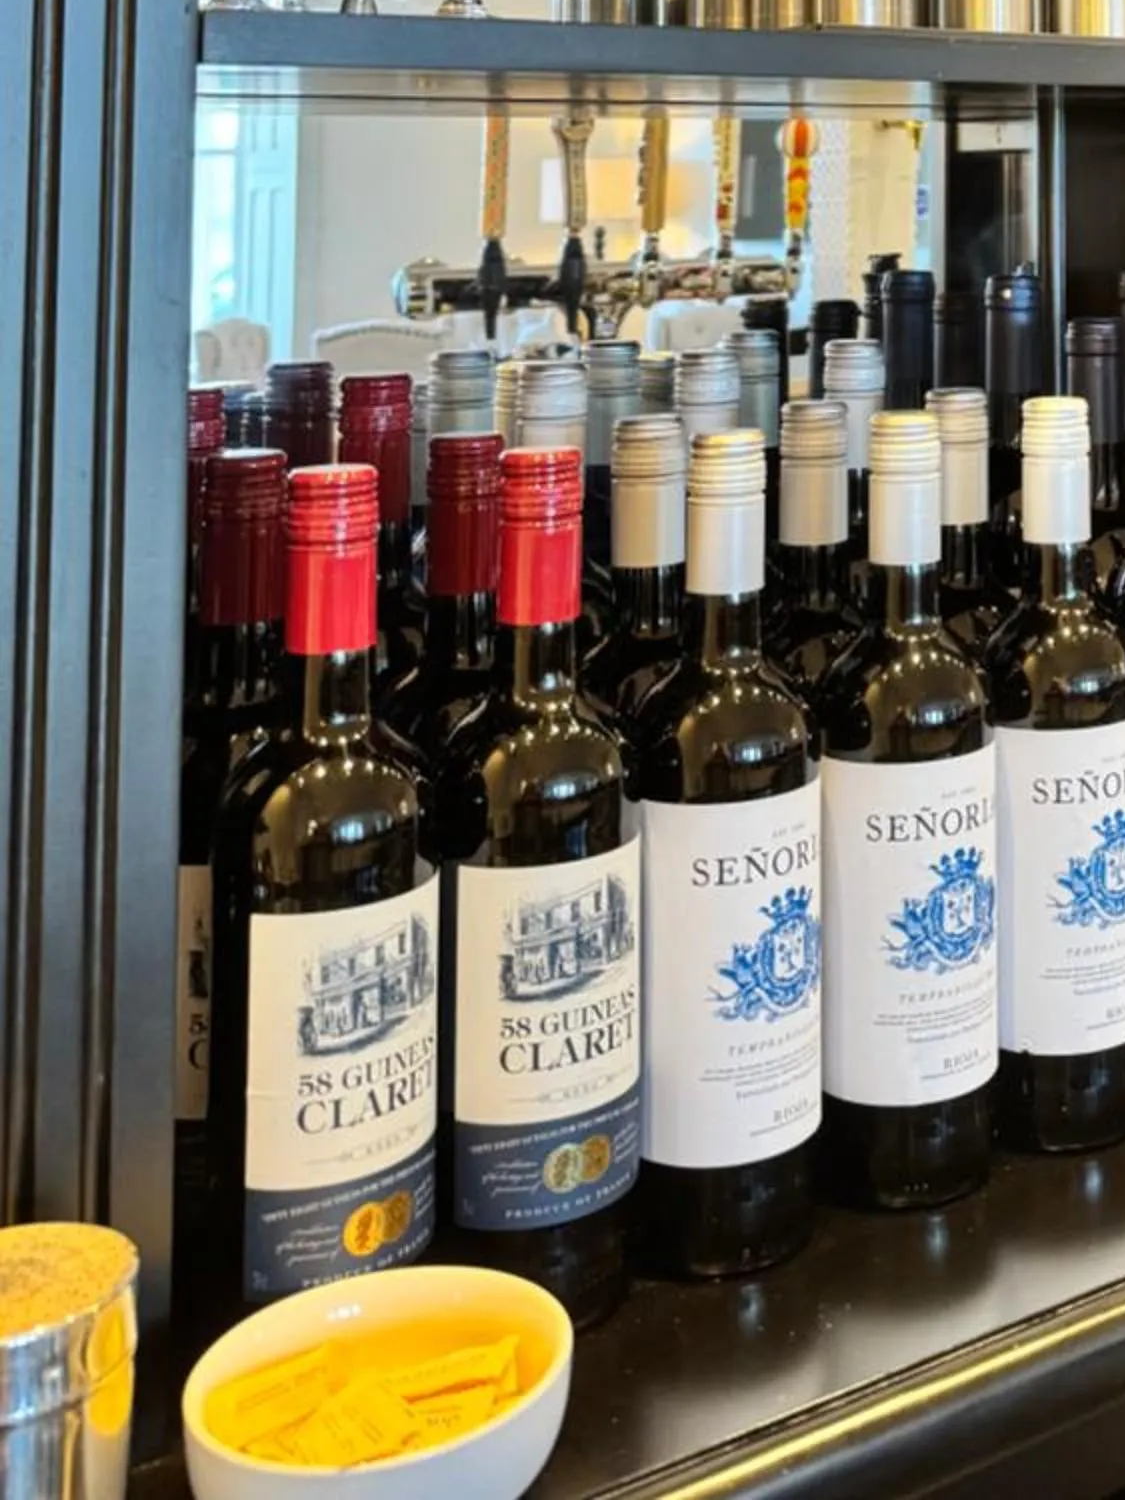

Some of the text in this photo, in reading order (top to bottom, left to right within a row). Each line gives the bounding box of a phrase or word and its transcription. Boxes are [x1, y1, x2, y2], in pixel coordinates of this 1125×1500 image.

[500, 1016, 532, 1040] 58
[500, 1009, 635, 1074] CLARET
[297, 1059, 433, 1135] CLARET
[298, 1071, 332, 1096] 58
